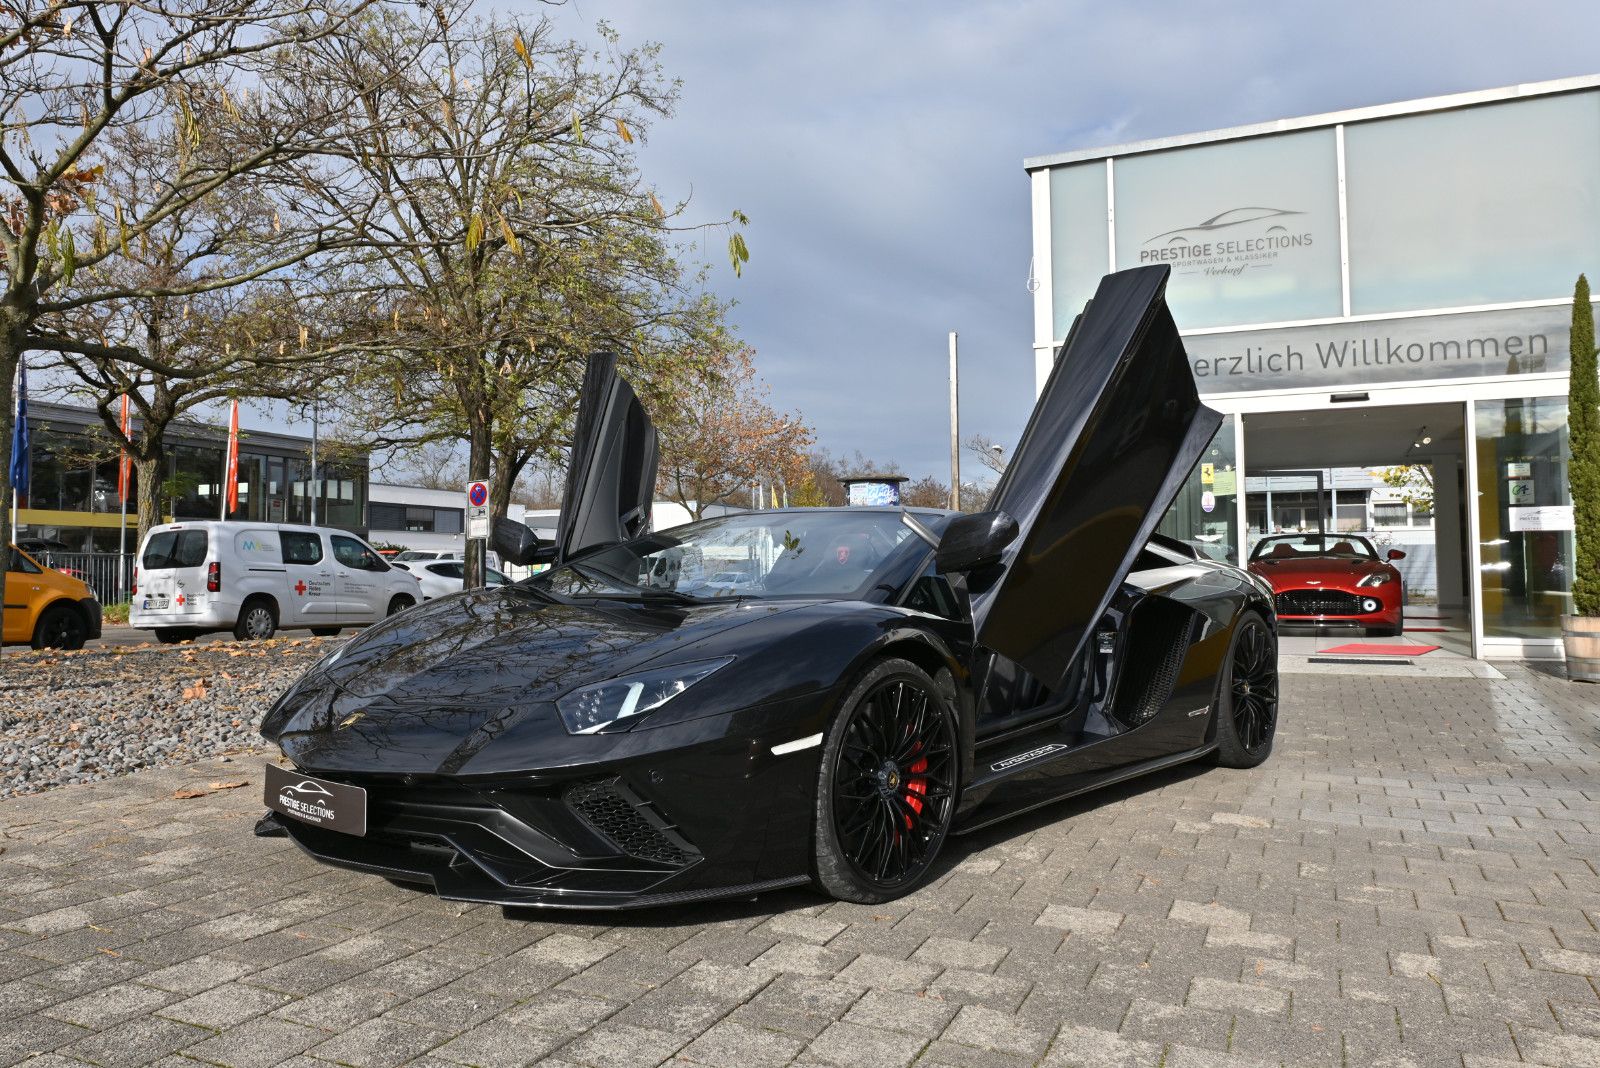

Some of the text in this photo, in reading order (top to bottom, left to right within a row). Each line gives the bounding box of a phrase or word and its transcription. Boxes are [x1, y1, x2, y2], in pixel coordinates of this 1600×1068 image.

[1140, 233, 1313, 262] PRESTIGE SELECTIONS
[1171, 257, 1224, 268] SPORTWAGEN
[1234, 251, 1279, 261] KLASSIKER
[1192, 332, 1548, 378] erzlich Willkommen
[279, 794, 335, 820] PRESTIGE SELECTIONS
